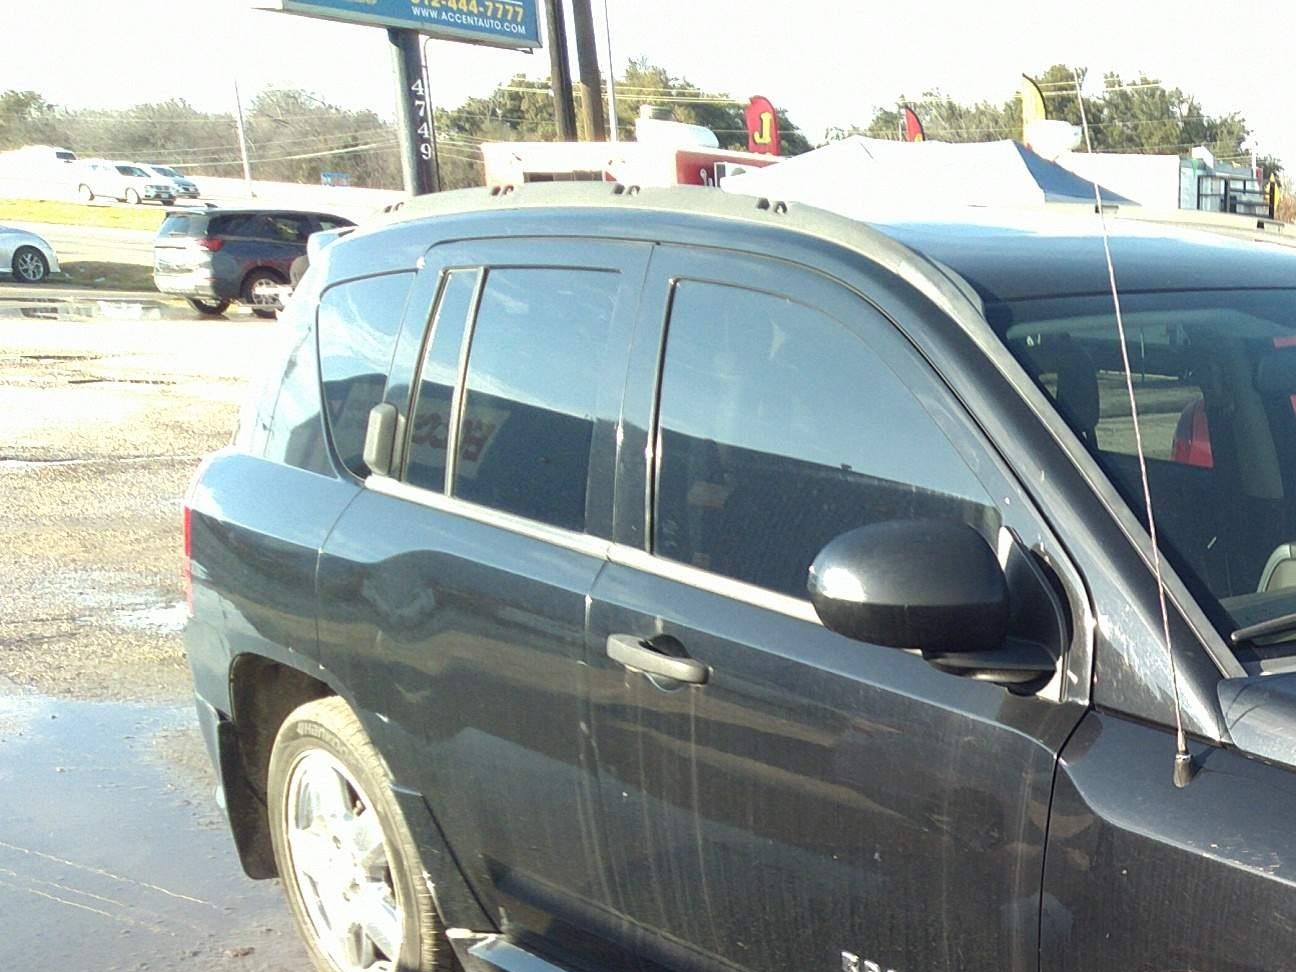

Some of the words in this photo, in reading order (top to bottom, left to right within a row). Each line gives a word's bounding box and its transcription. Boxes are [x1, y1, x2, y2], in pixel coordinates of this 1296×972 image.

[411, 0, 524, 23] 2-444-7777
[411, 6, 526, 34] WWW.ACCENTAUTO.COM
[411, 78, 433, 160] 4749
[753, 111, 773, 145] J
